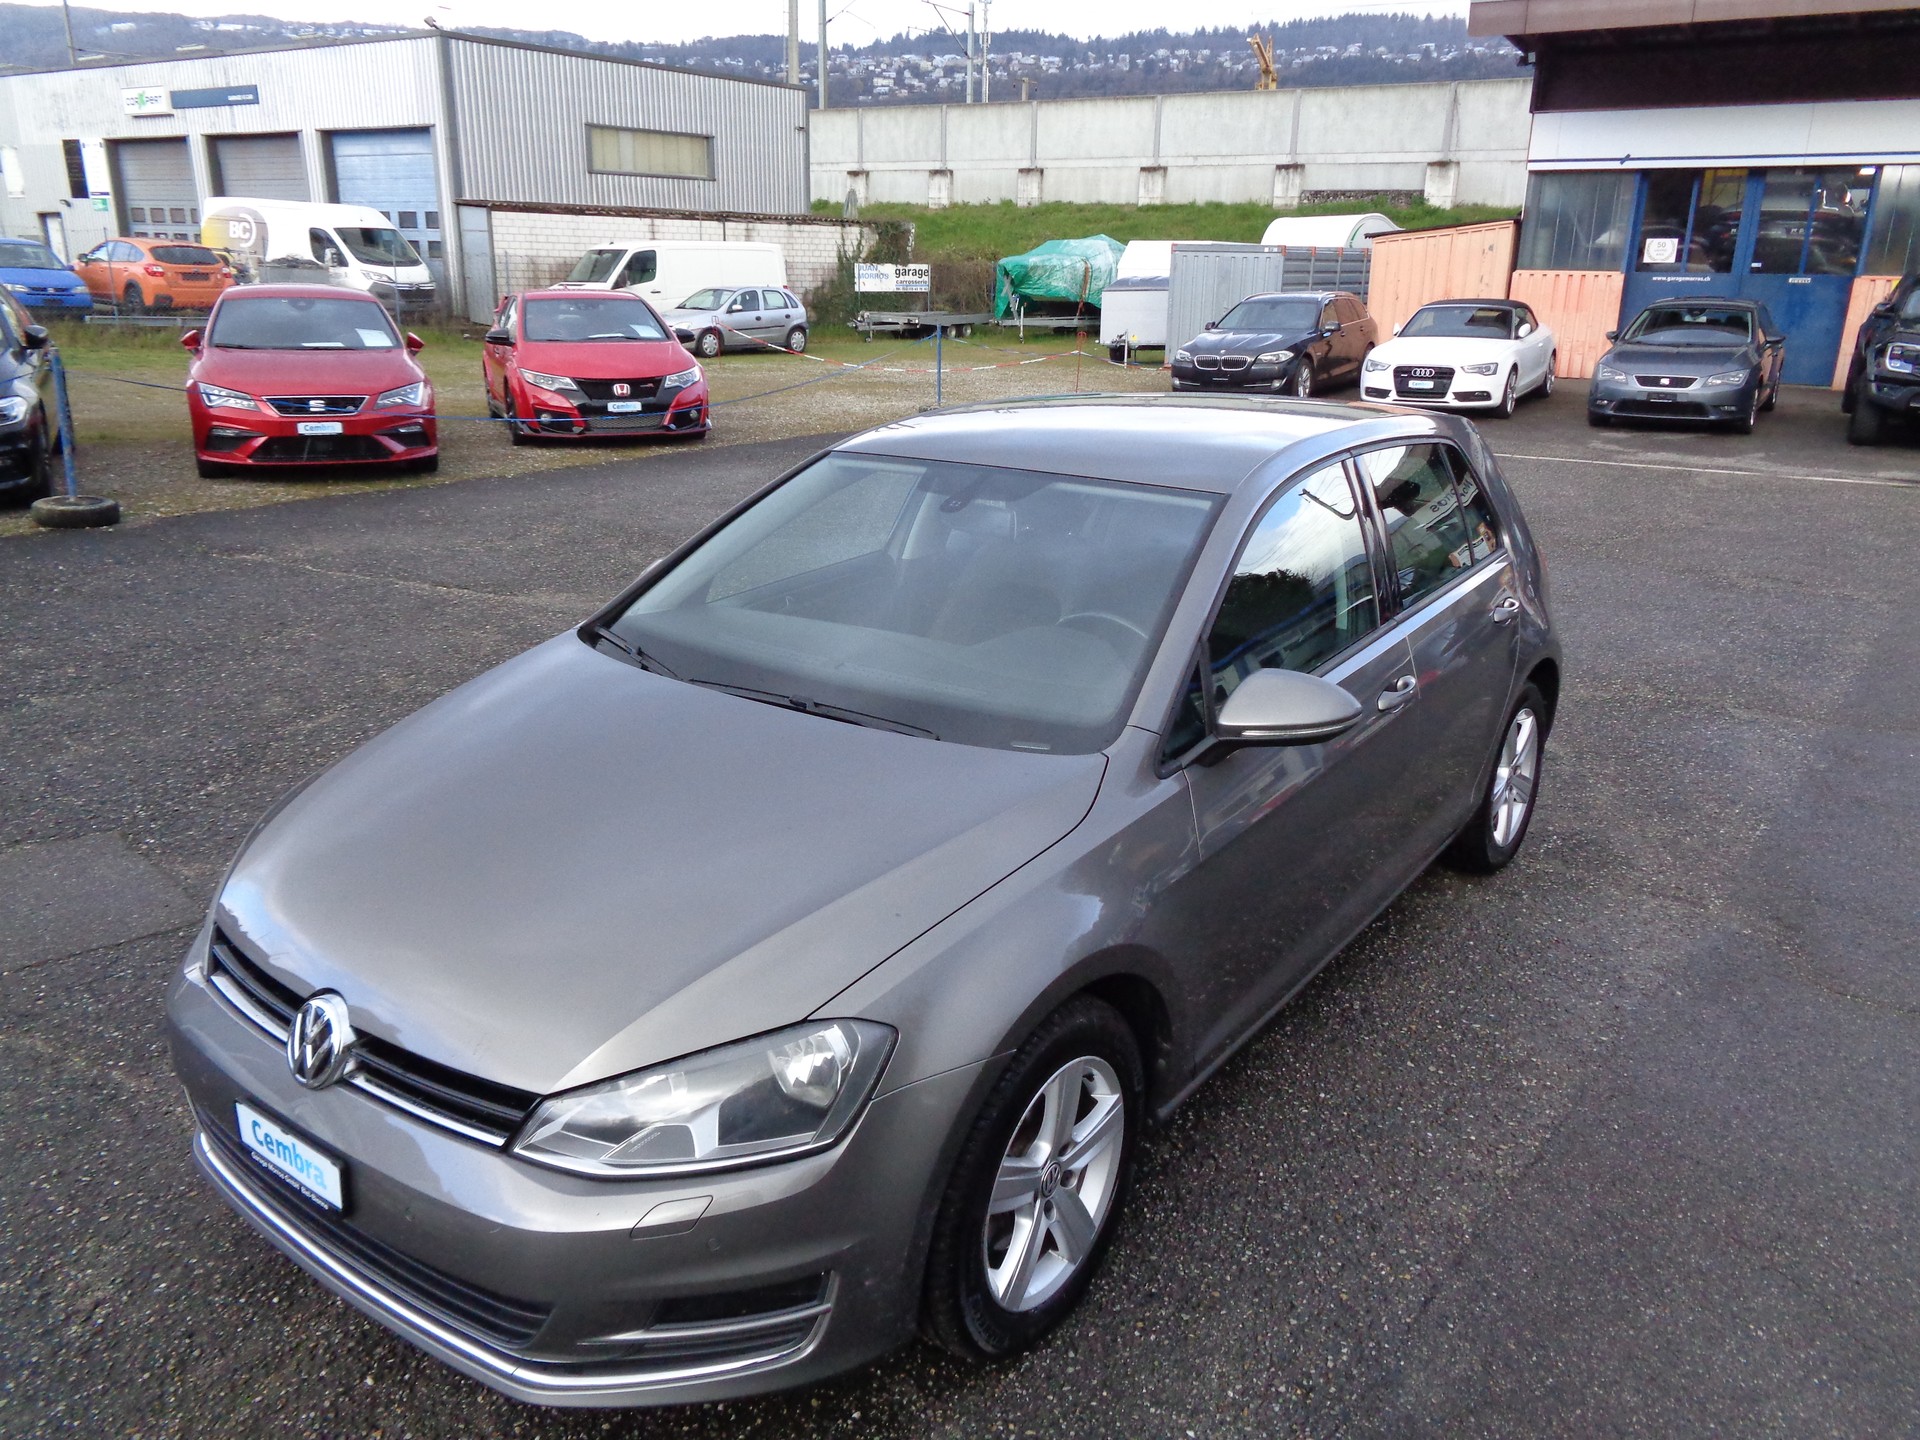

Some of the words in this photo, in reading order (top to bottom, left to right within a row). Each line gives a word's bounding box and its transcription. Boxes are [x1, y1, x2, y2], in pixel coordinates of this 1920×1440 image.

[229, 220, 251, 239] BC
[895, 268, 929, 278] garage
[251, 1120, 327, 1190] Cembra
